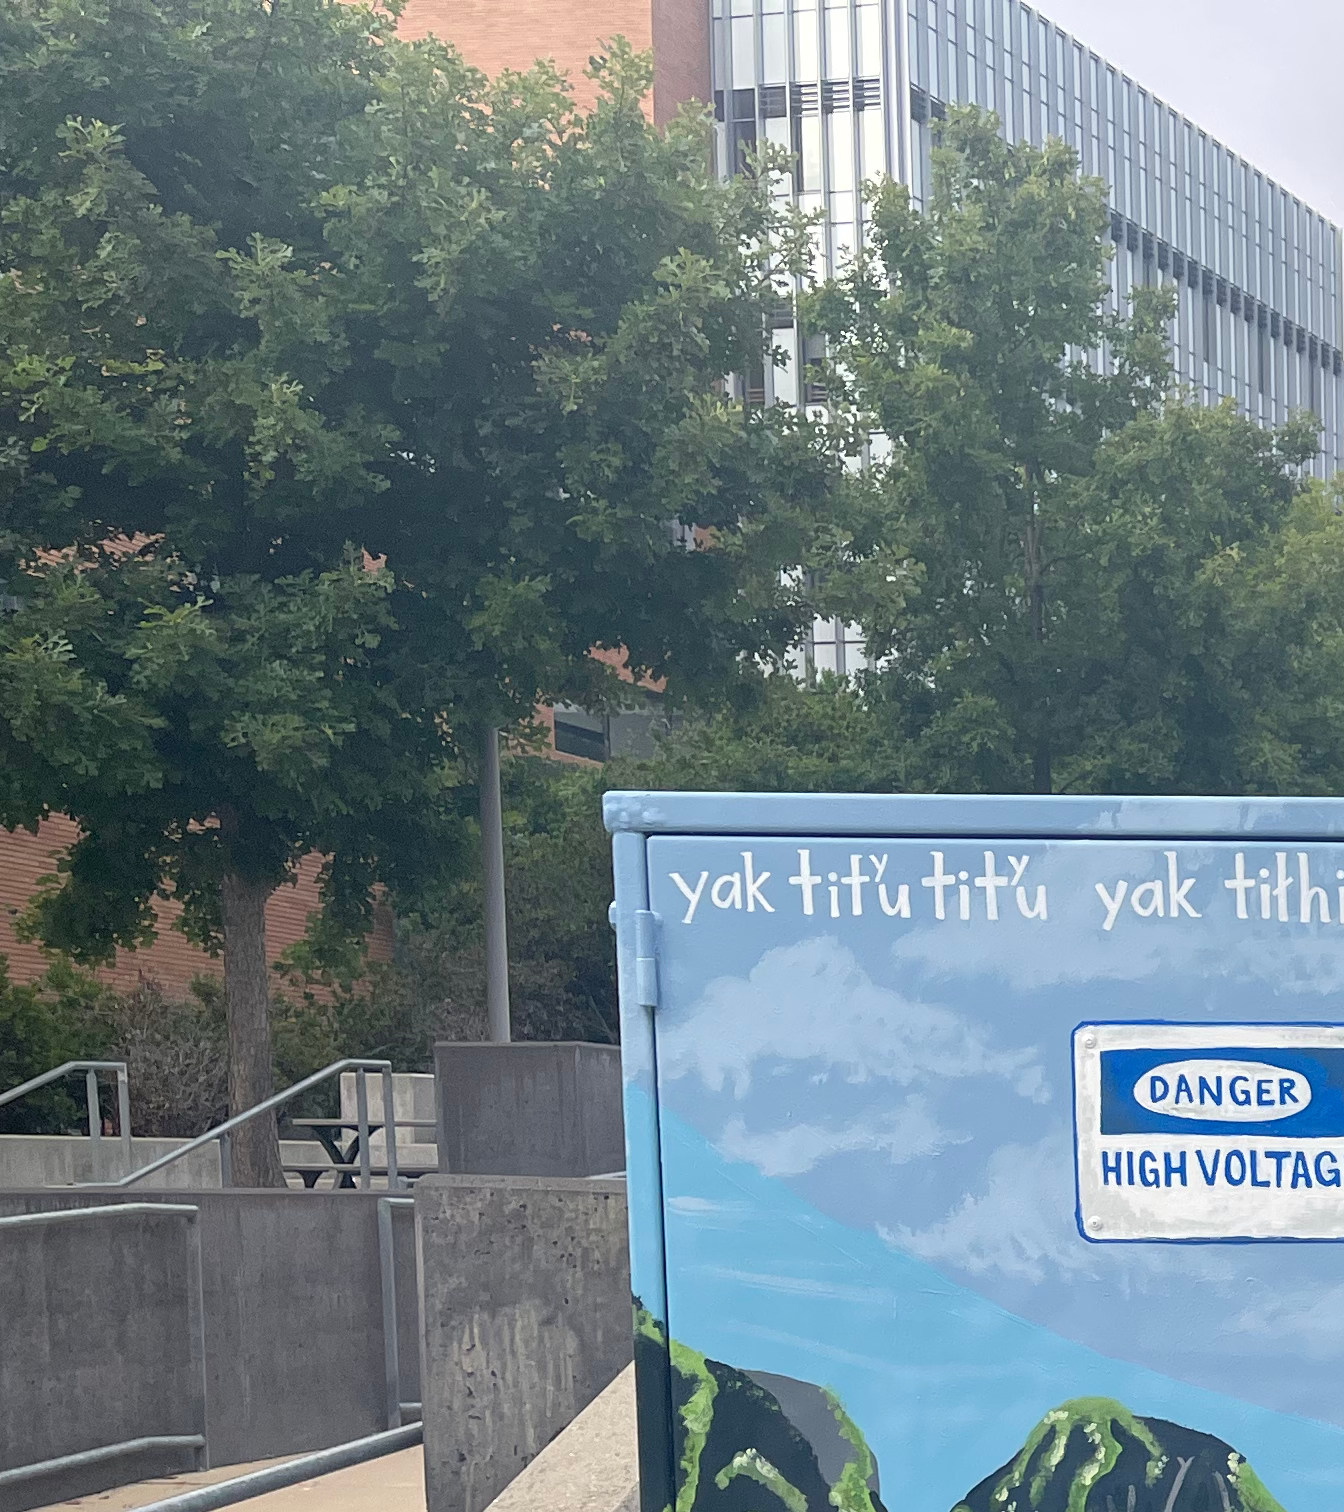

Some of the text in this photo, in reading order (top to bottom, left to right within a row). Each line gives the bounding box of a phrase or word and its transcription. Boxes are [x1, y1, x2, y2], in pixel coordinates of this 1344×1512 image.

[669, 851, 776, 924] yak
[1095, 851, 1202, 931] yak
[1150, 1074, 1300, 1106] DANGER
[1102, 1150, 1188, 1188] HIGH
